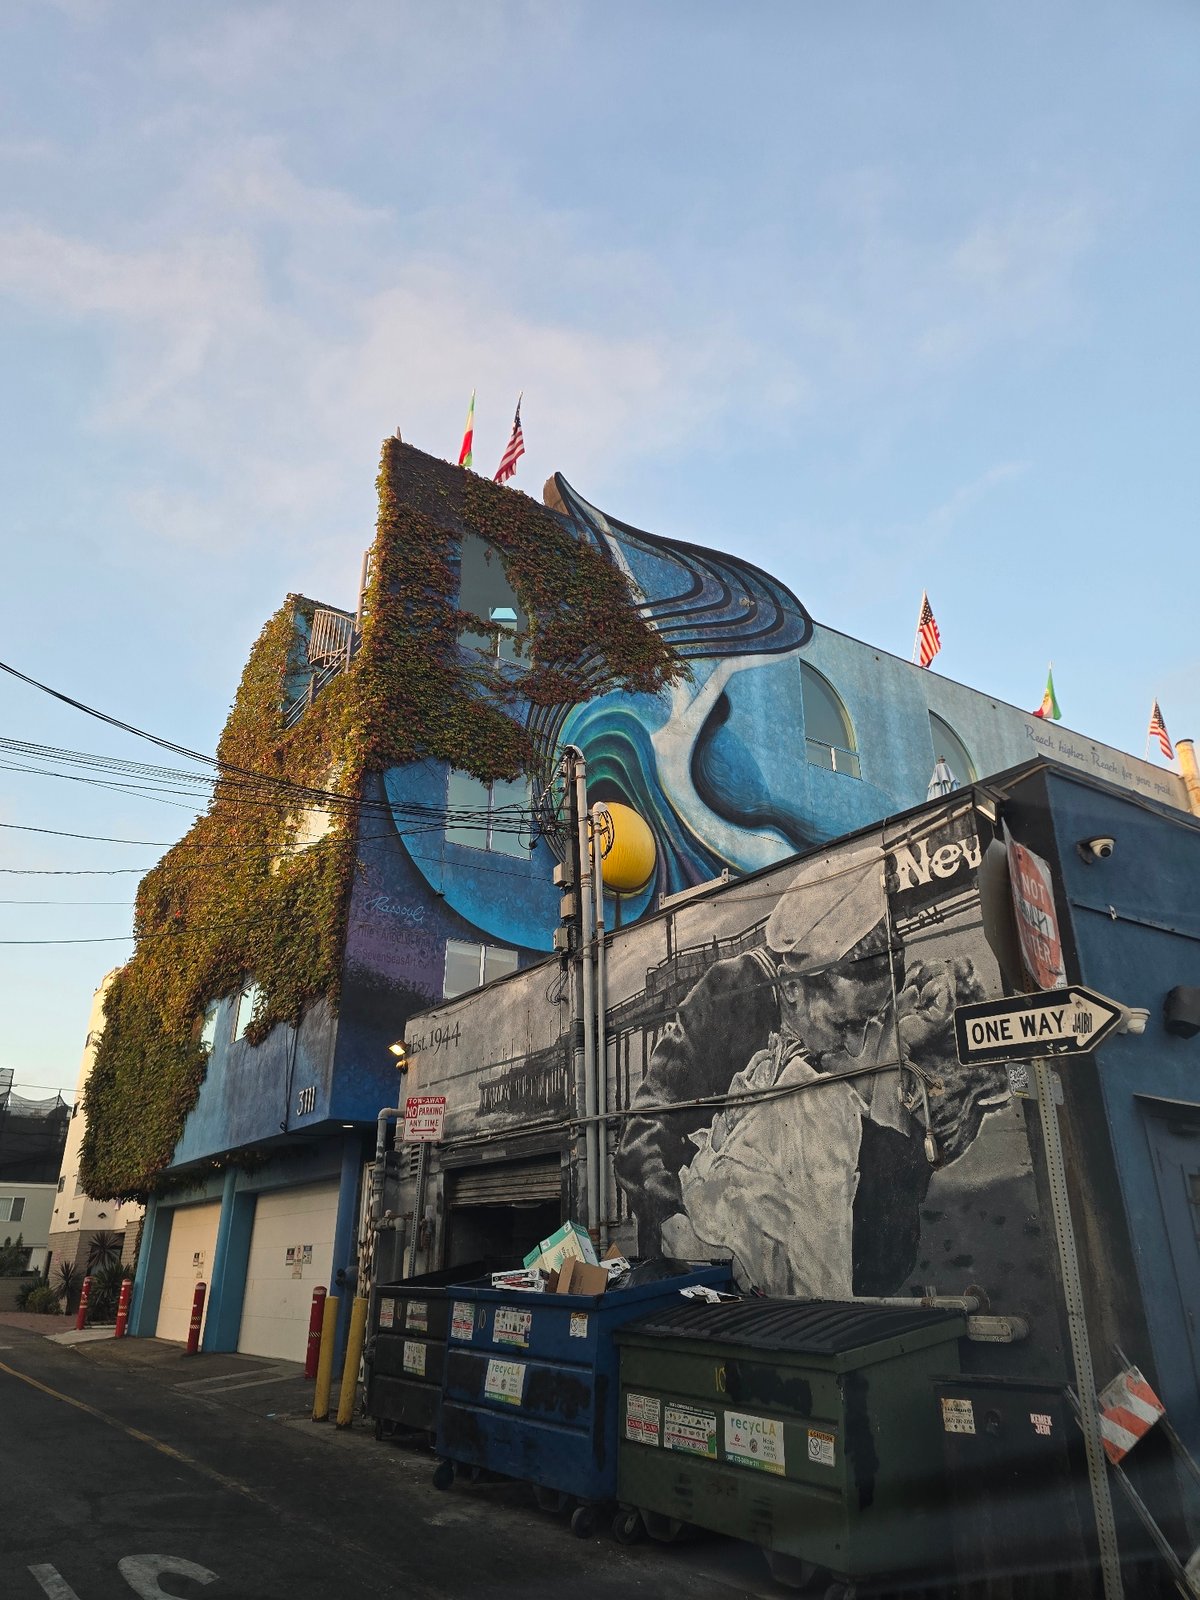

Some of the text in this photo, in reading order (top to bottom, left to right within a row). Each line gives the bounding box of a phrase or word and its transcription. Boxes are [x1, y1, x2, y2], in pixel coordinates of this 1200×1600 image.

[1024, 724, 1055, 749] Reach
[1091, 751, 1118, 774] Reach
[1020, 872, 1045, 905] NOT
[411, 1021, 461, 1056] Est. 1944
[971, 1010, 1065, 1044] ONE WAY
[296, 1085, 316, 1116] 3111
[407, 1106, 443, 1118] NO PARKING
[730, 1418, 777, 1437] recycLA
